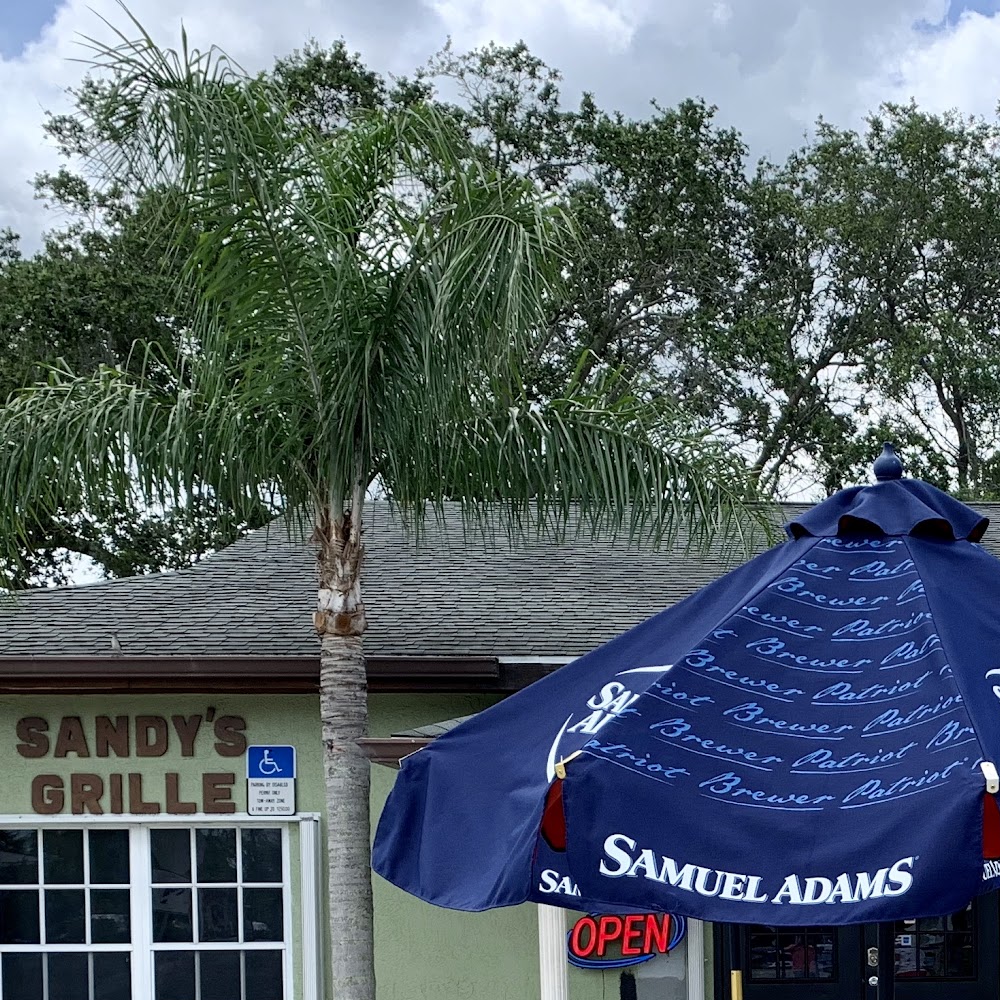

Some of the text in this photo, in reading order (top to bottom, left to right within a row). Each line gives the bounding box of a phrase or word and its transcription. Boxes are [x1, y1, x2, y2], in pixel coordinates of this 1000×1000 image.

[767, 577, 889, 606] Brewer
[685, 649, 933, 700] Brewer Patriot
[746, 637, 873, 668] Brewer
[15, 706, 248, 759] SANDY'S
[723, 702, 854, 734] Brewer
[650, 718, 784, 763] Brewer
[791, 742, 919, 769] Patriot
[31, 772, 237, 815] GRILLE
[699, 771, 836, 804] Brewer
[842, 757, 969, 804] Patriot
[599, 833, 916, 906] SAMUEL ADAMS
[571, 913, 672, 957] OPEN
